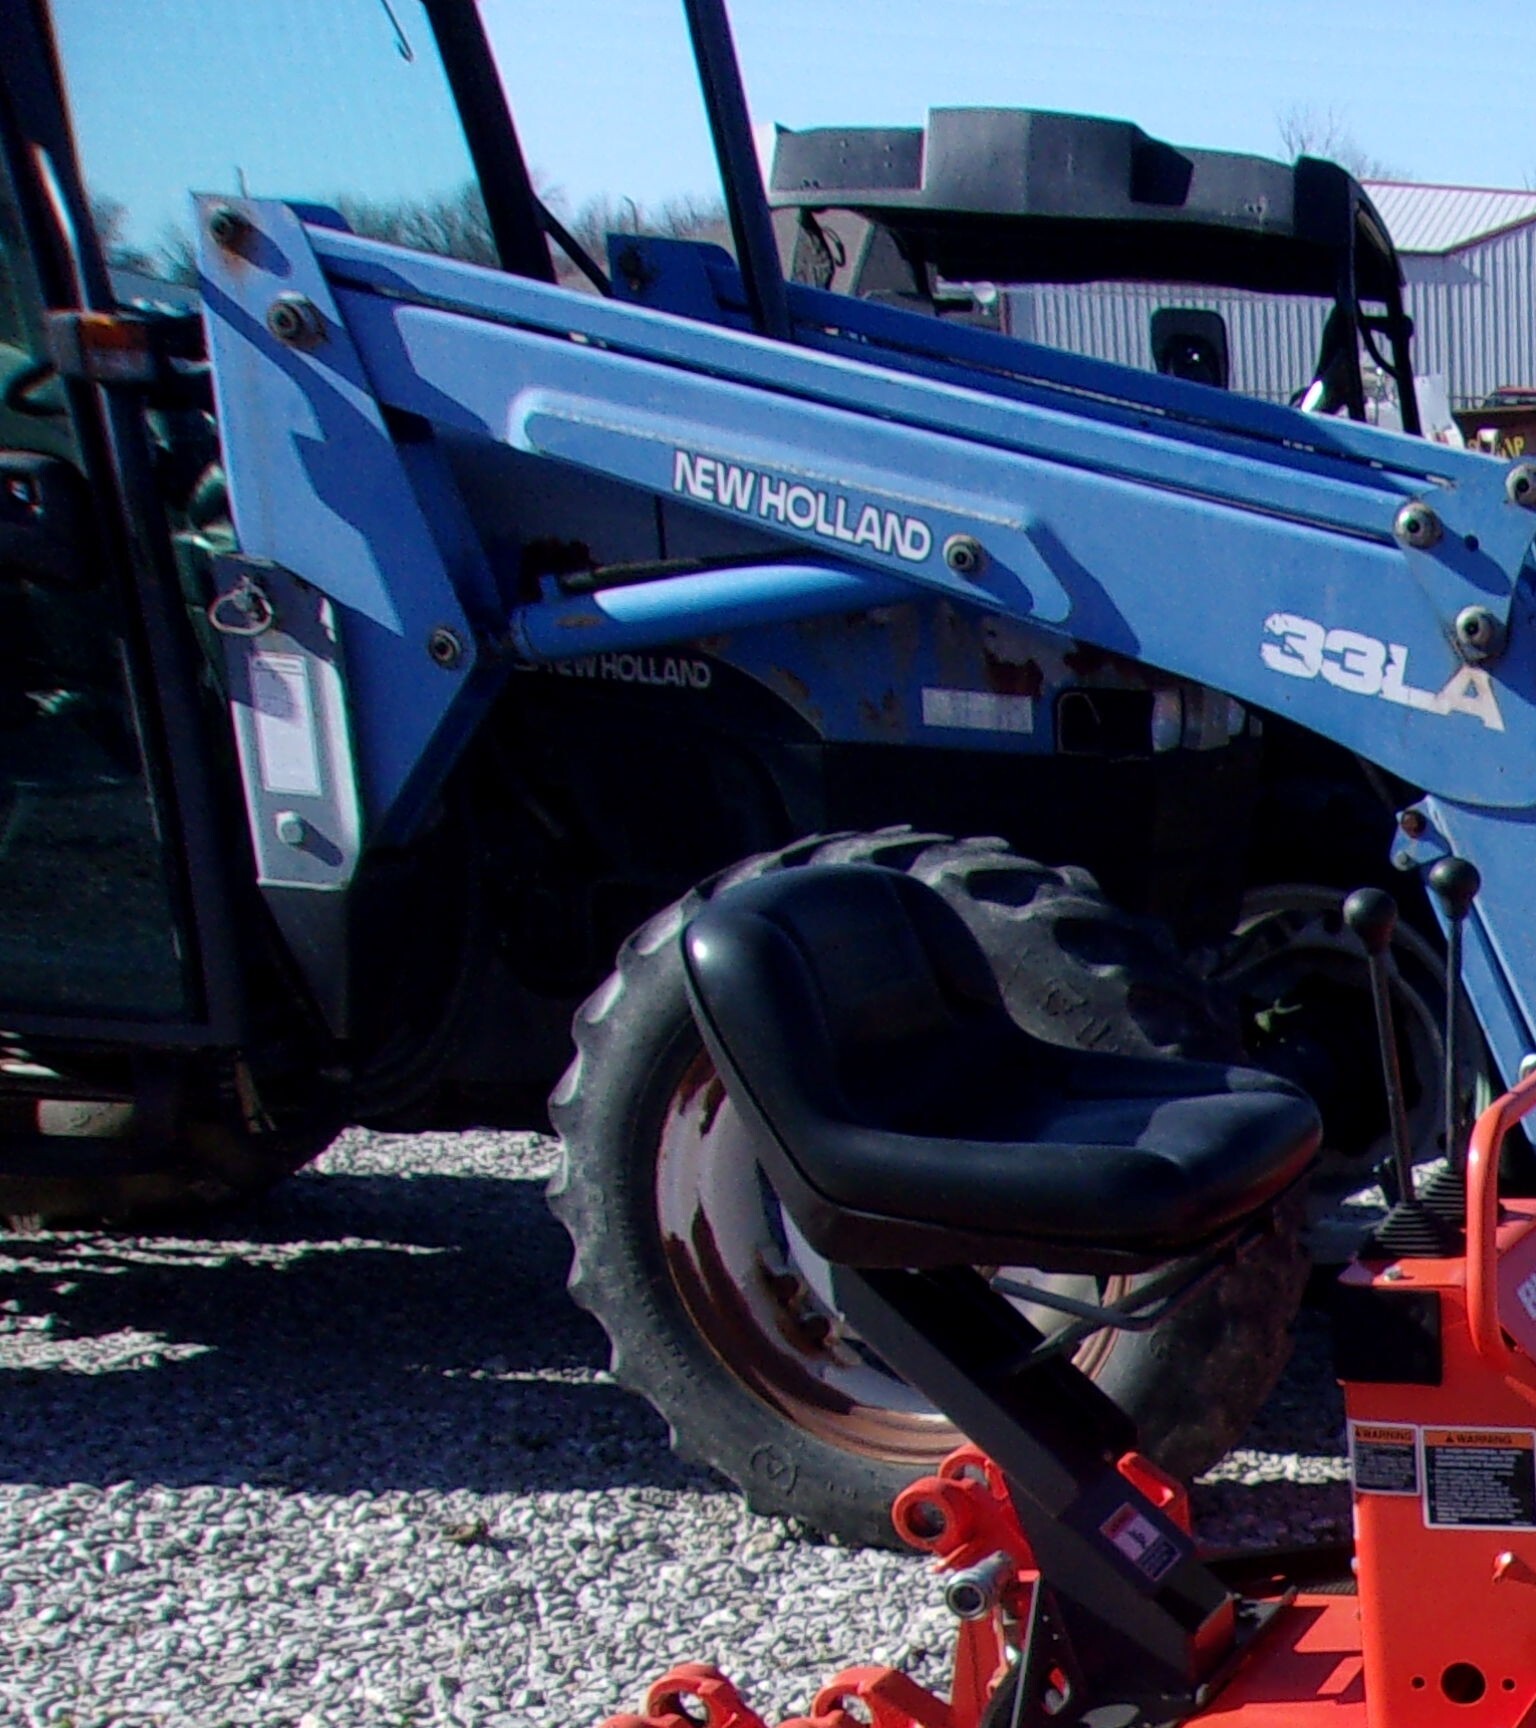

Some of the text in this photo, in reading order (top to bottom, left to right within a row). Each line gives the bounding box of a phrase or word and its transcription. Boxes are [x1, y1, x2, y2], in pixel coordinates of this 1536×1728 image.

[673, 449, 932, 563] NEW HOLLAND
[600, 653, 712, 688] HOLLAND
[1260, 612, 1505, 732] 33LA
